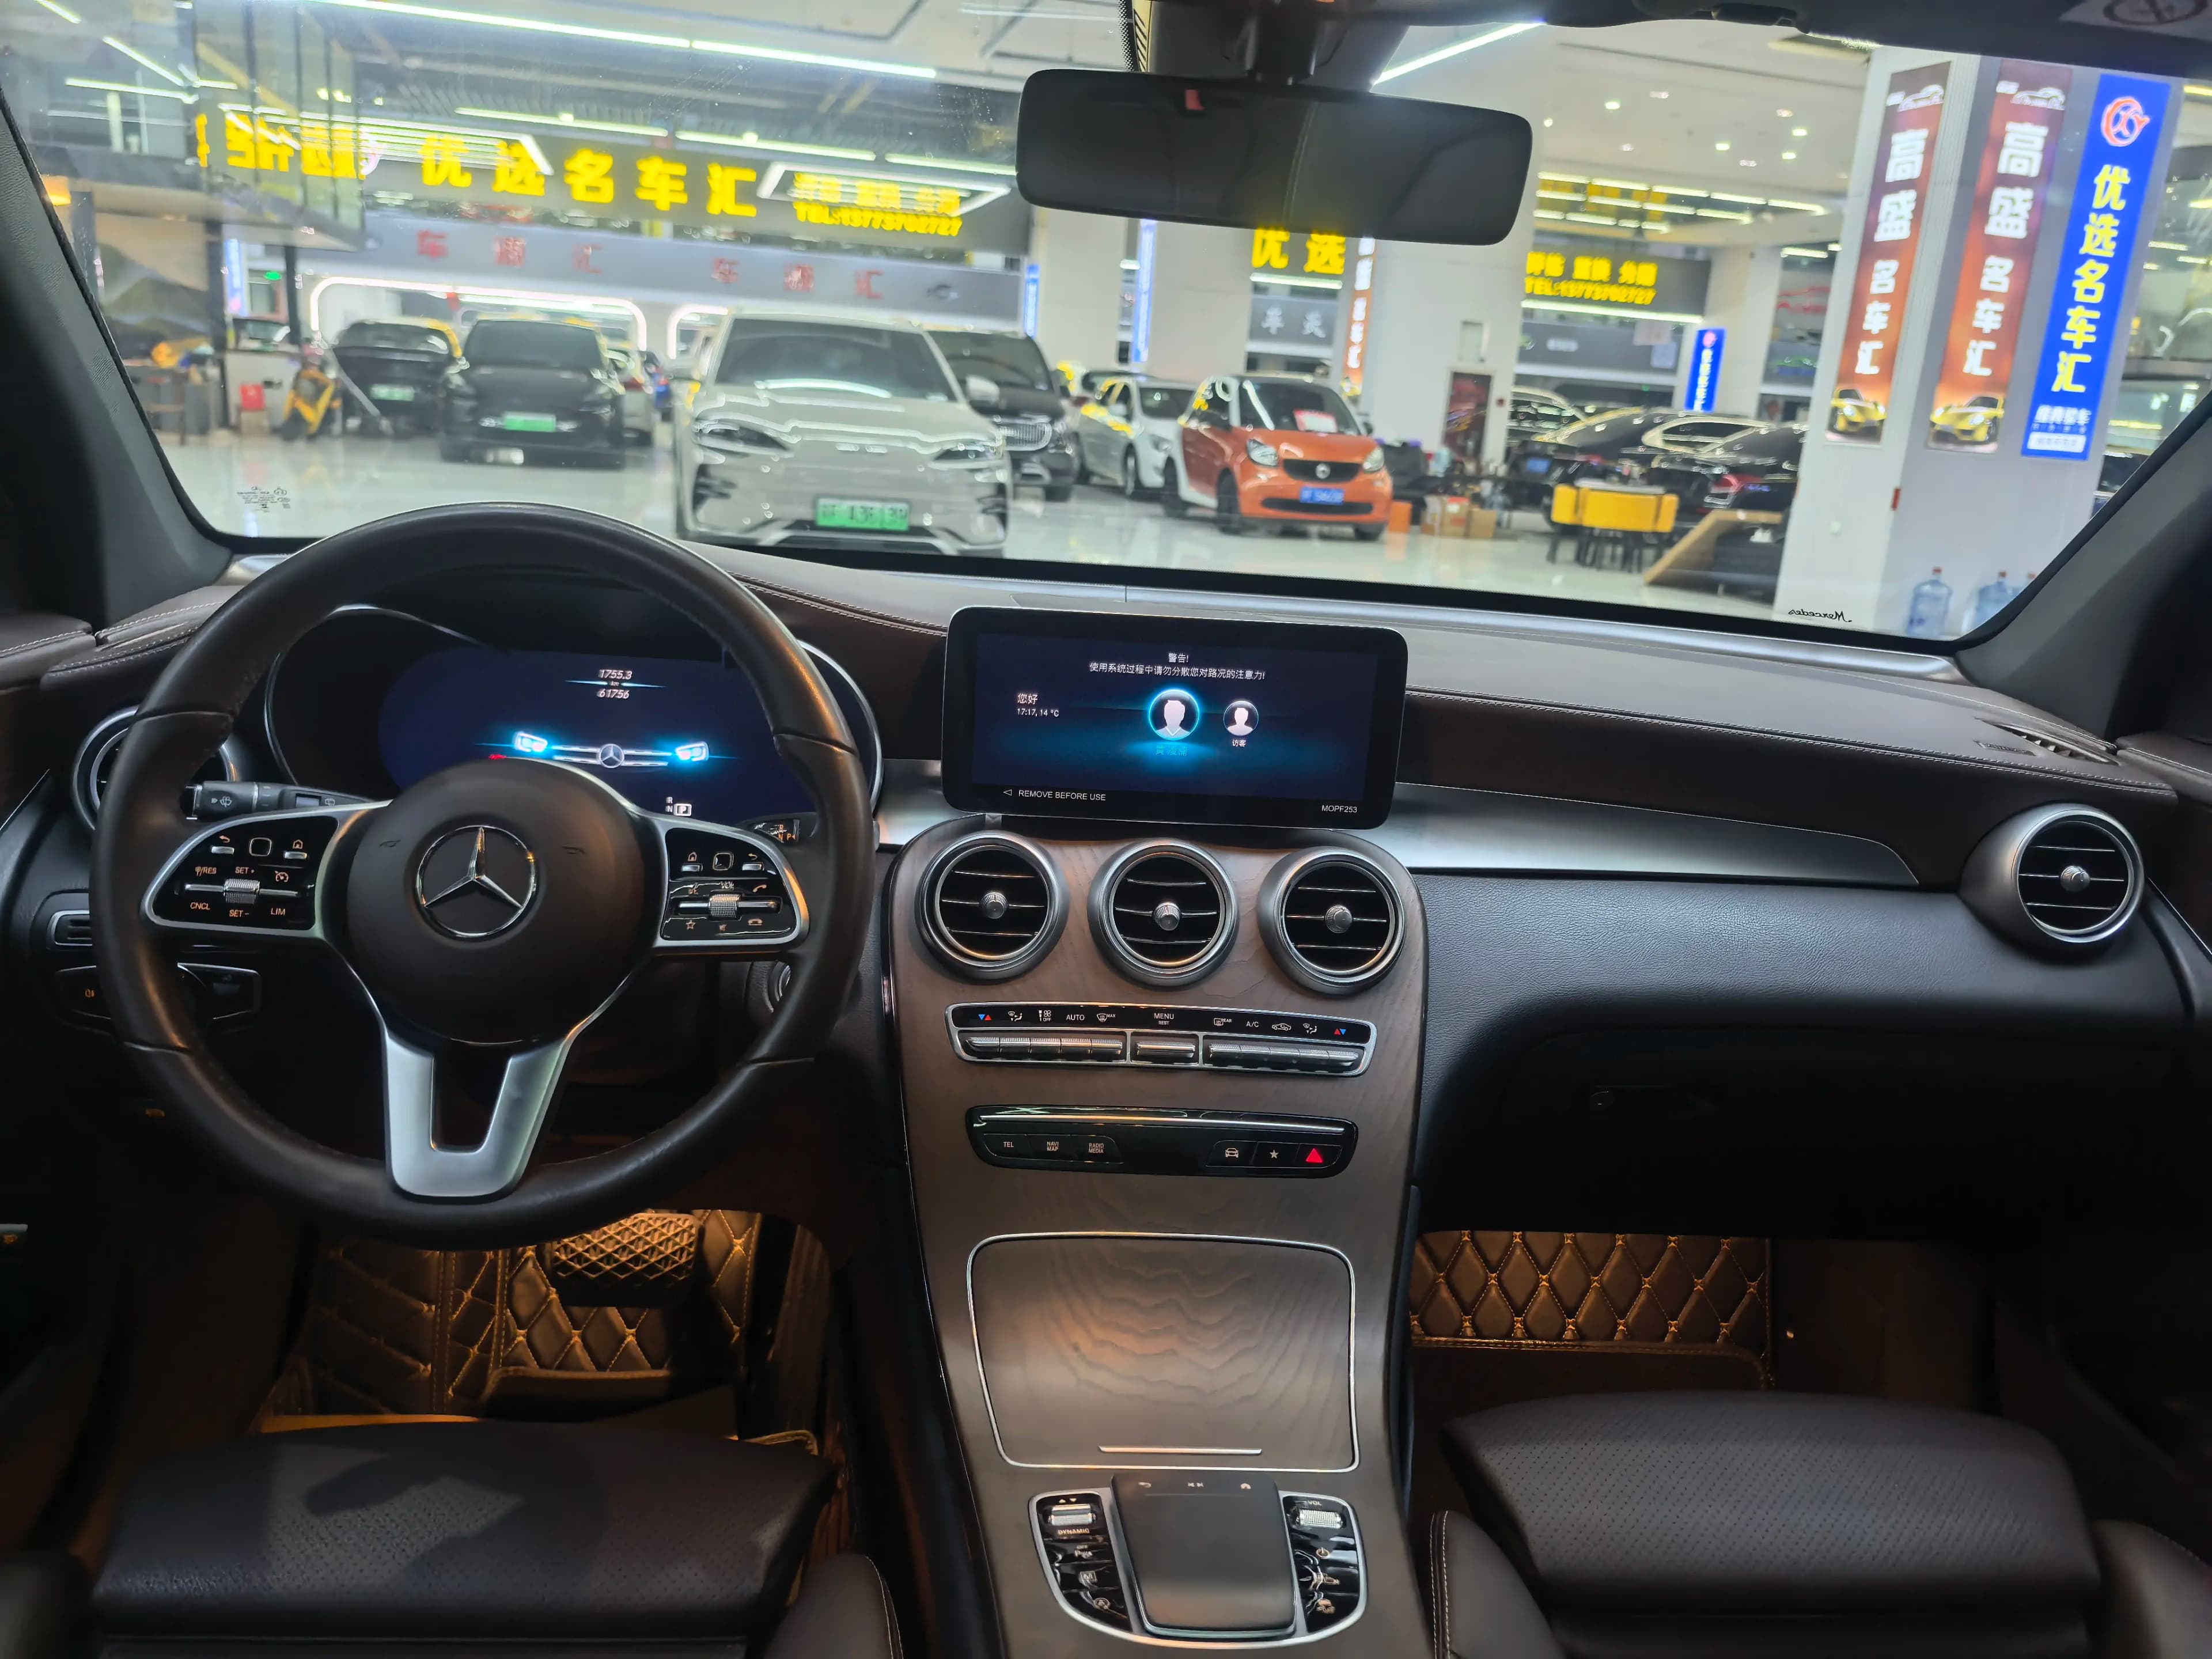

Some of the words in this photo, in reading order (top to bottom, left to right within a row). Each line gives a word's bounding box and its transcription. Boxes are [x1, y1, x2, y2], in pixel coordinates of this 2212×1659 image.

[419, 136, 757, 217] 优选名车汇
[1854, 128, 1929, 375] 高盛名车汇
[1963, 121, 2048, 376] 高盛名车汇
[2051, 164, 2131, 393] 优选名车汇
[1168, 653, 1189, 663] 警告!
[599, 669, 632, 680] 1755.3
[1089, 662, 1266, 680] 使用系统过程中请勿分散您对路况的注意力!
[597, 688, 630, 699] 61756
[1017, 693, 1038, 704] 您好
[1232, 739, 1246, 747] 访客
[1018, 790, 1053, 798] REMOVE
[1055, 792, 1088, 800] BEFORE
[1321, 805, 1357, 813] MOPF253
[190, 902, 211, 910] CNCL
